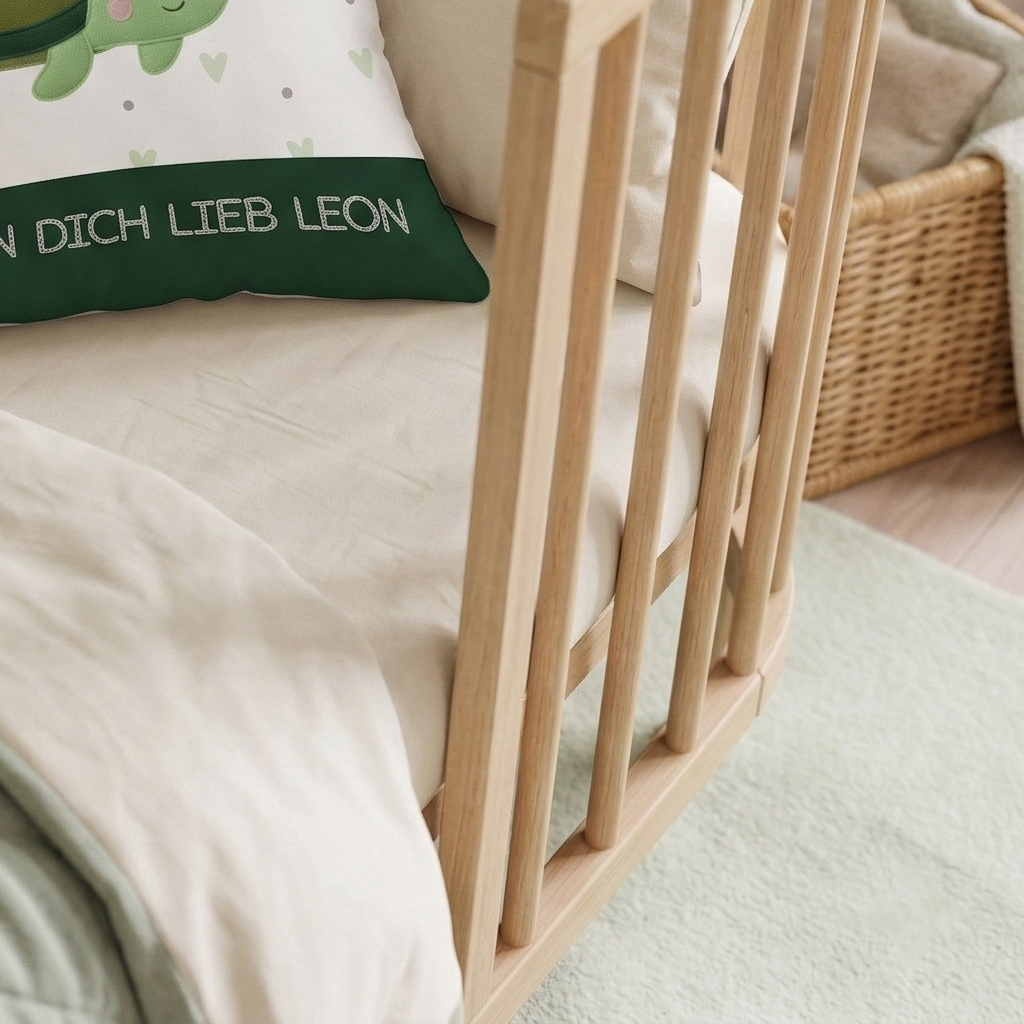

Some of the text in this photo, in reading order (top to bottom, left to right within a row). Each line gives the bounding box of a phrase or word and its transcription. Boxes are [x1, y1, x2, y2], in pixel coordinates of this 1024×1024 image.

[36, 205, 150, 255] DICH
[168, 196, 278, 237] LIEB
[294, 196, 410, 235] LEON
